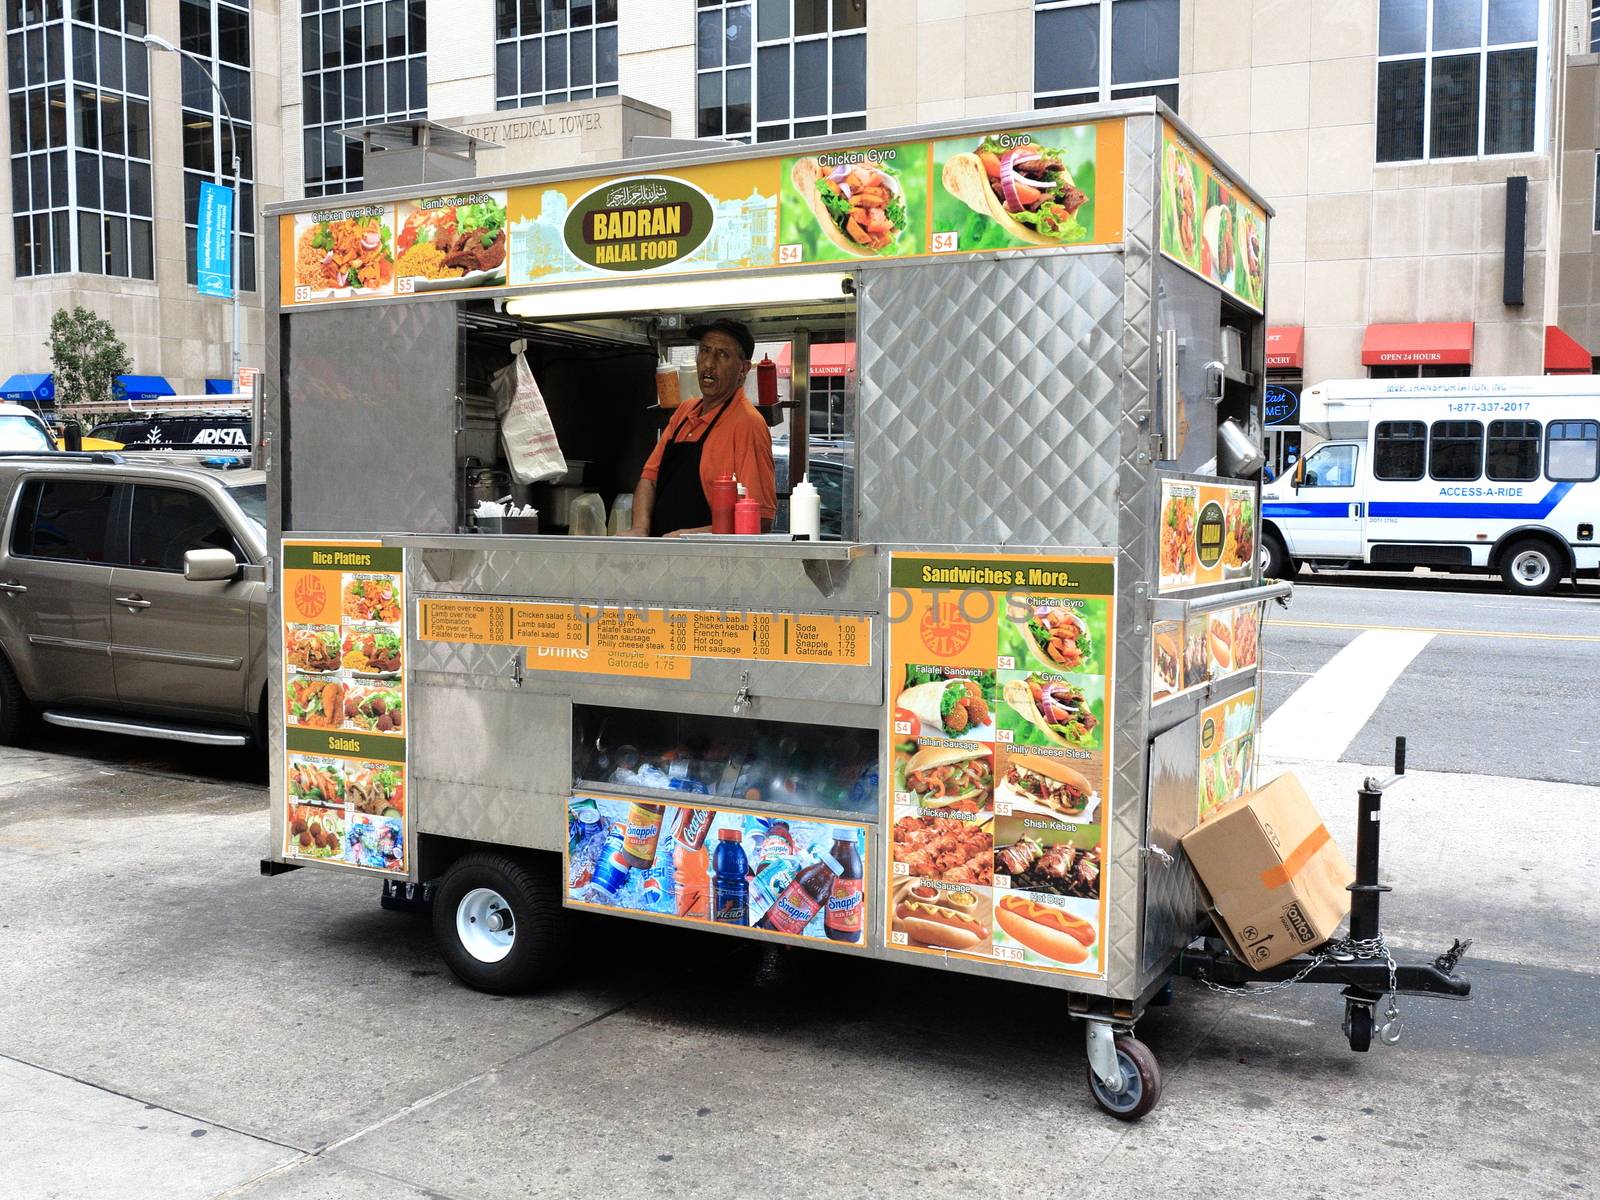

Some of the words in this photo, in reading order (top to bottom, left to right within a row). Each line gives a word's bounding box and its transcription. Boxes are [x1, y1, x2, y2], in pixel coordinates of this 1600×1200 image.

[502, 118, 555, 141] MEDICAL
[559, 112, 602, 133] TOWER
[1000, 134, 1030, 149] Gyro
[818, 152, 864, 167] Chicken
[868, 149, 896, 165] Gyro
[421, 196, 445, 210] Lamb
[447, 197, 465, 207] over
[468, 193, 489, 204] Rice
[312, 210, 344, 223] Chicken
[345, 209, 363, 218] over
[365, 206, 384, 217] Rice
[593, 206, 680, 240] BADRAN
[934, 235, 953, 250] $4
[595, 244, 637, 264] HALAL
[641, 240, 677, 261] FOOD
[781, 247, 798, 261] $4
[399, 278, 412, 292] $5
[296, 287, 308, 300] $5
[1413, 353, 1440, 361] HOURS
[1448, 403, 1530, 412] 1-877-337-2017
[192, 428, 247, 445] ARISTA
[1440, 488, 1523, 497] ACCESS-A-RIDE
[313, 551, 332, 565] Rice
[334, 551, 371, 566] Platters
[922, 565, 1012, 585] Sandwiches
[1014, 569, 1026, 585] &
[1028, 569, 1079, 587] More...
[1026, 597, 1061, 608] Chicken
[1063, 598, 1084, 609] Gyro
[431, 617, 470, 625] Combination
[694, 614, 715, 622] Shish
[623, 627, 656, 635] sandwich
[693, 622, 723, 630] Chicken
[726, 623, 749, 631] kebab
[796, 624, 817, 632] Soda
[838, 625, 856, 633] 1.00
[518, 629, 539, 637] Falafel
[694, 629, 719, 637] French
[721, 630, 738, 638] fries
[796, 632, 819, 640] Water
[838, 633, 856, 641] 1.00
[598, 640, 617, 649] Philly
[621, 635, 650, 643] sausage
[709, 638, 723, 646] dog
[796, 639, 828, 649] Snapple
[838, 641, 856, 649] 1.75
[709, 646, 741, 654] sausage
[753, 647, 770, 655] 2.00
[796, 647, 832, 656] Gatorade
[838, 649, 856, 657] 1.75
[608, 658, 649, 669] Gatorade
[655, 661, 674, 670] 1.75
[999, 657, 1012, 668] $4
[915, 665, 943, 675] Falafel
[944, 666, 983, 677] Sandwich
[1041, 672, 1062, 683] Gyro
[896, 722, 908, 733] $4
[998, 731, 1011, 741] $4
[328, 736, 360, 752] Salads
[917, 737, 941, 748] Italian
[942, 739, 979, 751] Sausage
[1006, 745, 1029, 756] Philly
[1031, 746, 1063, 757] Cheese
[1065, 749, 1092, 760] Steak
[896, 793, 907, 803] $4
[996, 803, 1009, 814] $5
[917, 807, 949, 819] Chicken
[950, 810, 977, 822] Kebab
[1023, 818, 1048, 829] Shish
[1050, 821, 1077, 832] Kebab
[894, 862, 906, 873] $3
[920, 879, 934, 890] Hot
[936, 881, 971, 893] Sausage
[995, 876, 1008, 887] $3
[1030, 893, 1046, 903] Hot
[1048, 894, 1065, 906] Dog
[893, 933, 905, 943] $2
[994, 948, 1023, 960] $1.50
